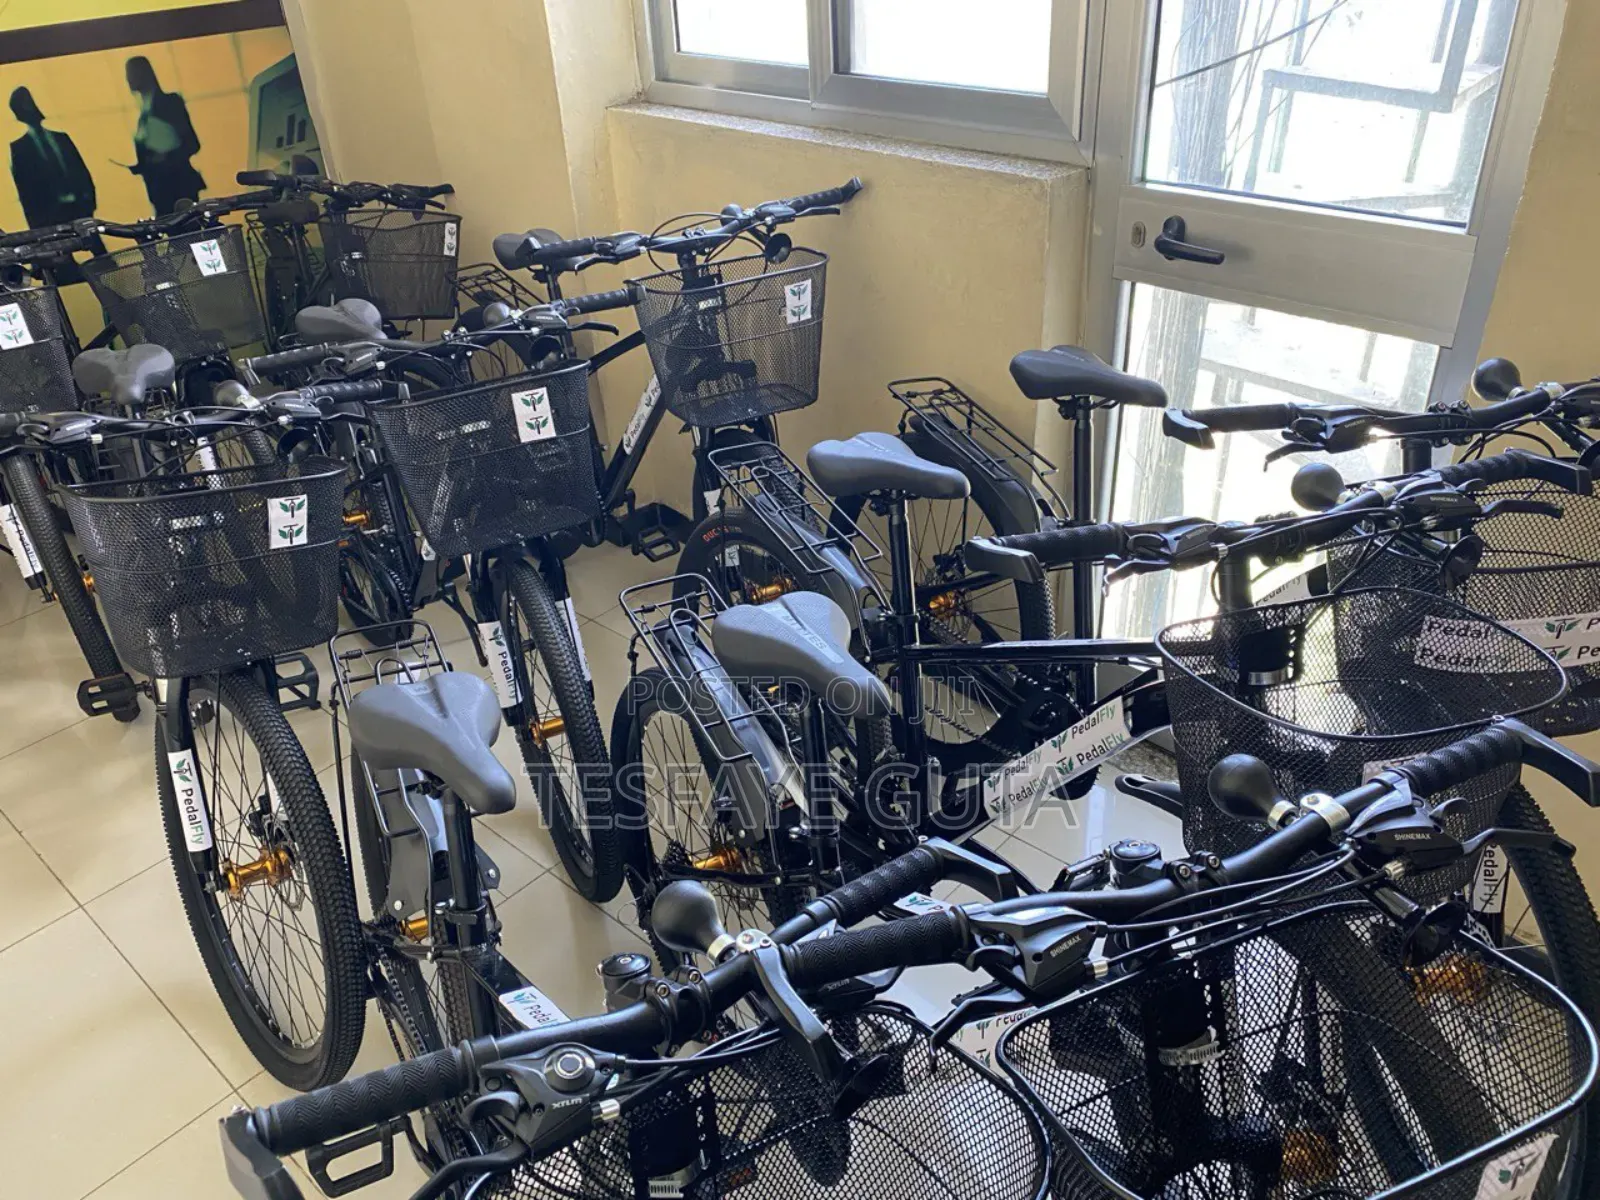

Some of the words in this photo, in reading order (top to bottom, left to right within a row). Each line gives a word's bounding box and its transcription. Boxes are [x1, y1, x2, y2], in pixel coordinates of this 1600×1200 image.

[1070, 703, 1117, 739] PedalFly
[1076, 731, 1127, 766] PedalFly
[181, 787, 205, 845] PedalFly
